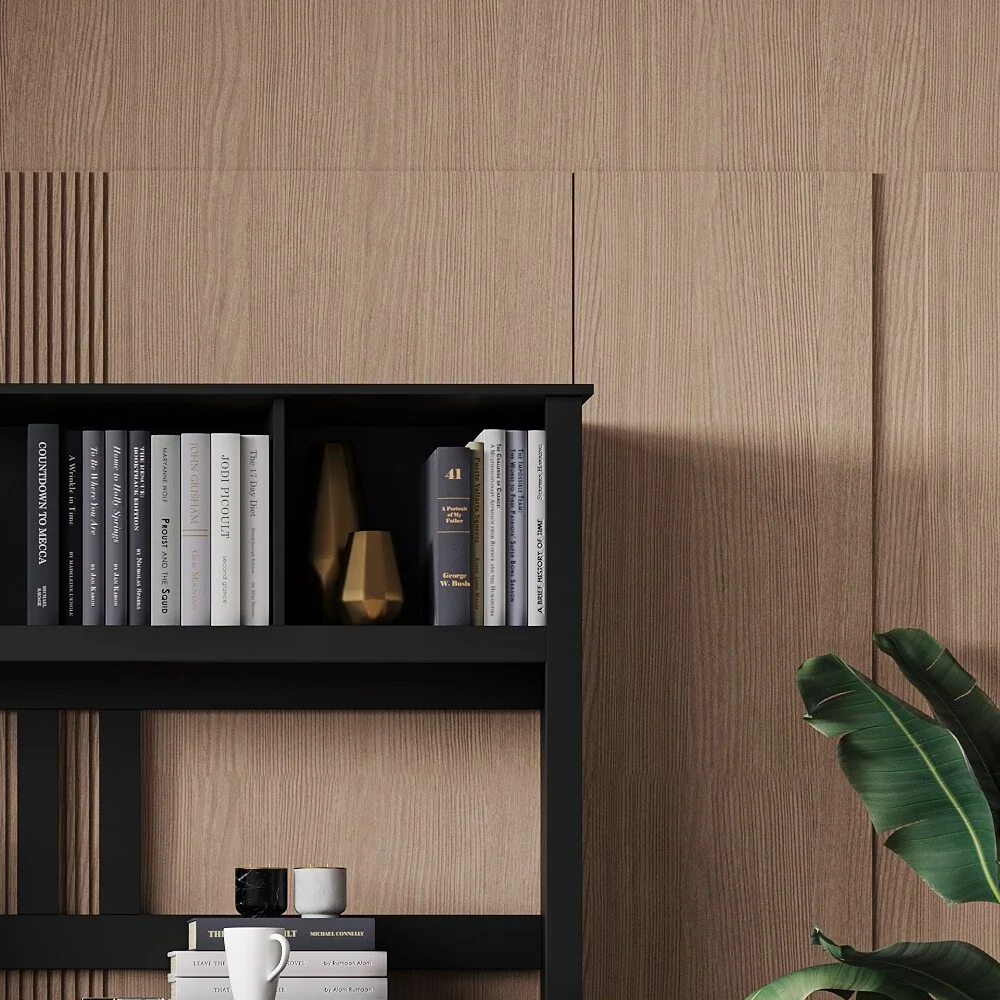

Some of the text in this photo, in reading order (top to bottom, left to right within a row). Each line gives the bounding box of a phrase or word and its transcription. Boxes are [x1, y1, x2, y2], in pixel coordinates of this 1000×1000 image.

[190, 442, 199, 524] JOHN GRISHAM
[250, 469, 257, 478] 17
[445, 468, 462, 480] 41
[91, 472, 99, 501] Where
[112, 445, 121, 543] Home to Holly Springs
[220, 454, 229, 539] JODI PICOULT
[248, 481, 257, 497] Day
[38, 441, 47, 565] COUNTDOWN TO MECCA
[69, 496, 76, 504] in
[91, 502, 99, 517] You
[91, 519, 99, 536] Are
[162, 518, 170, 548] PROUST
[537, 539, 543, 549] OF
[161, 588, 170, 614] SQUID
